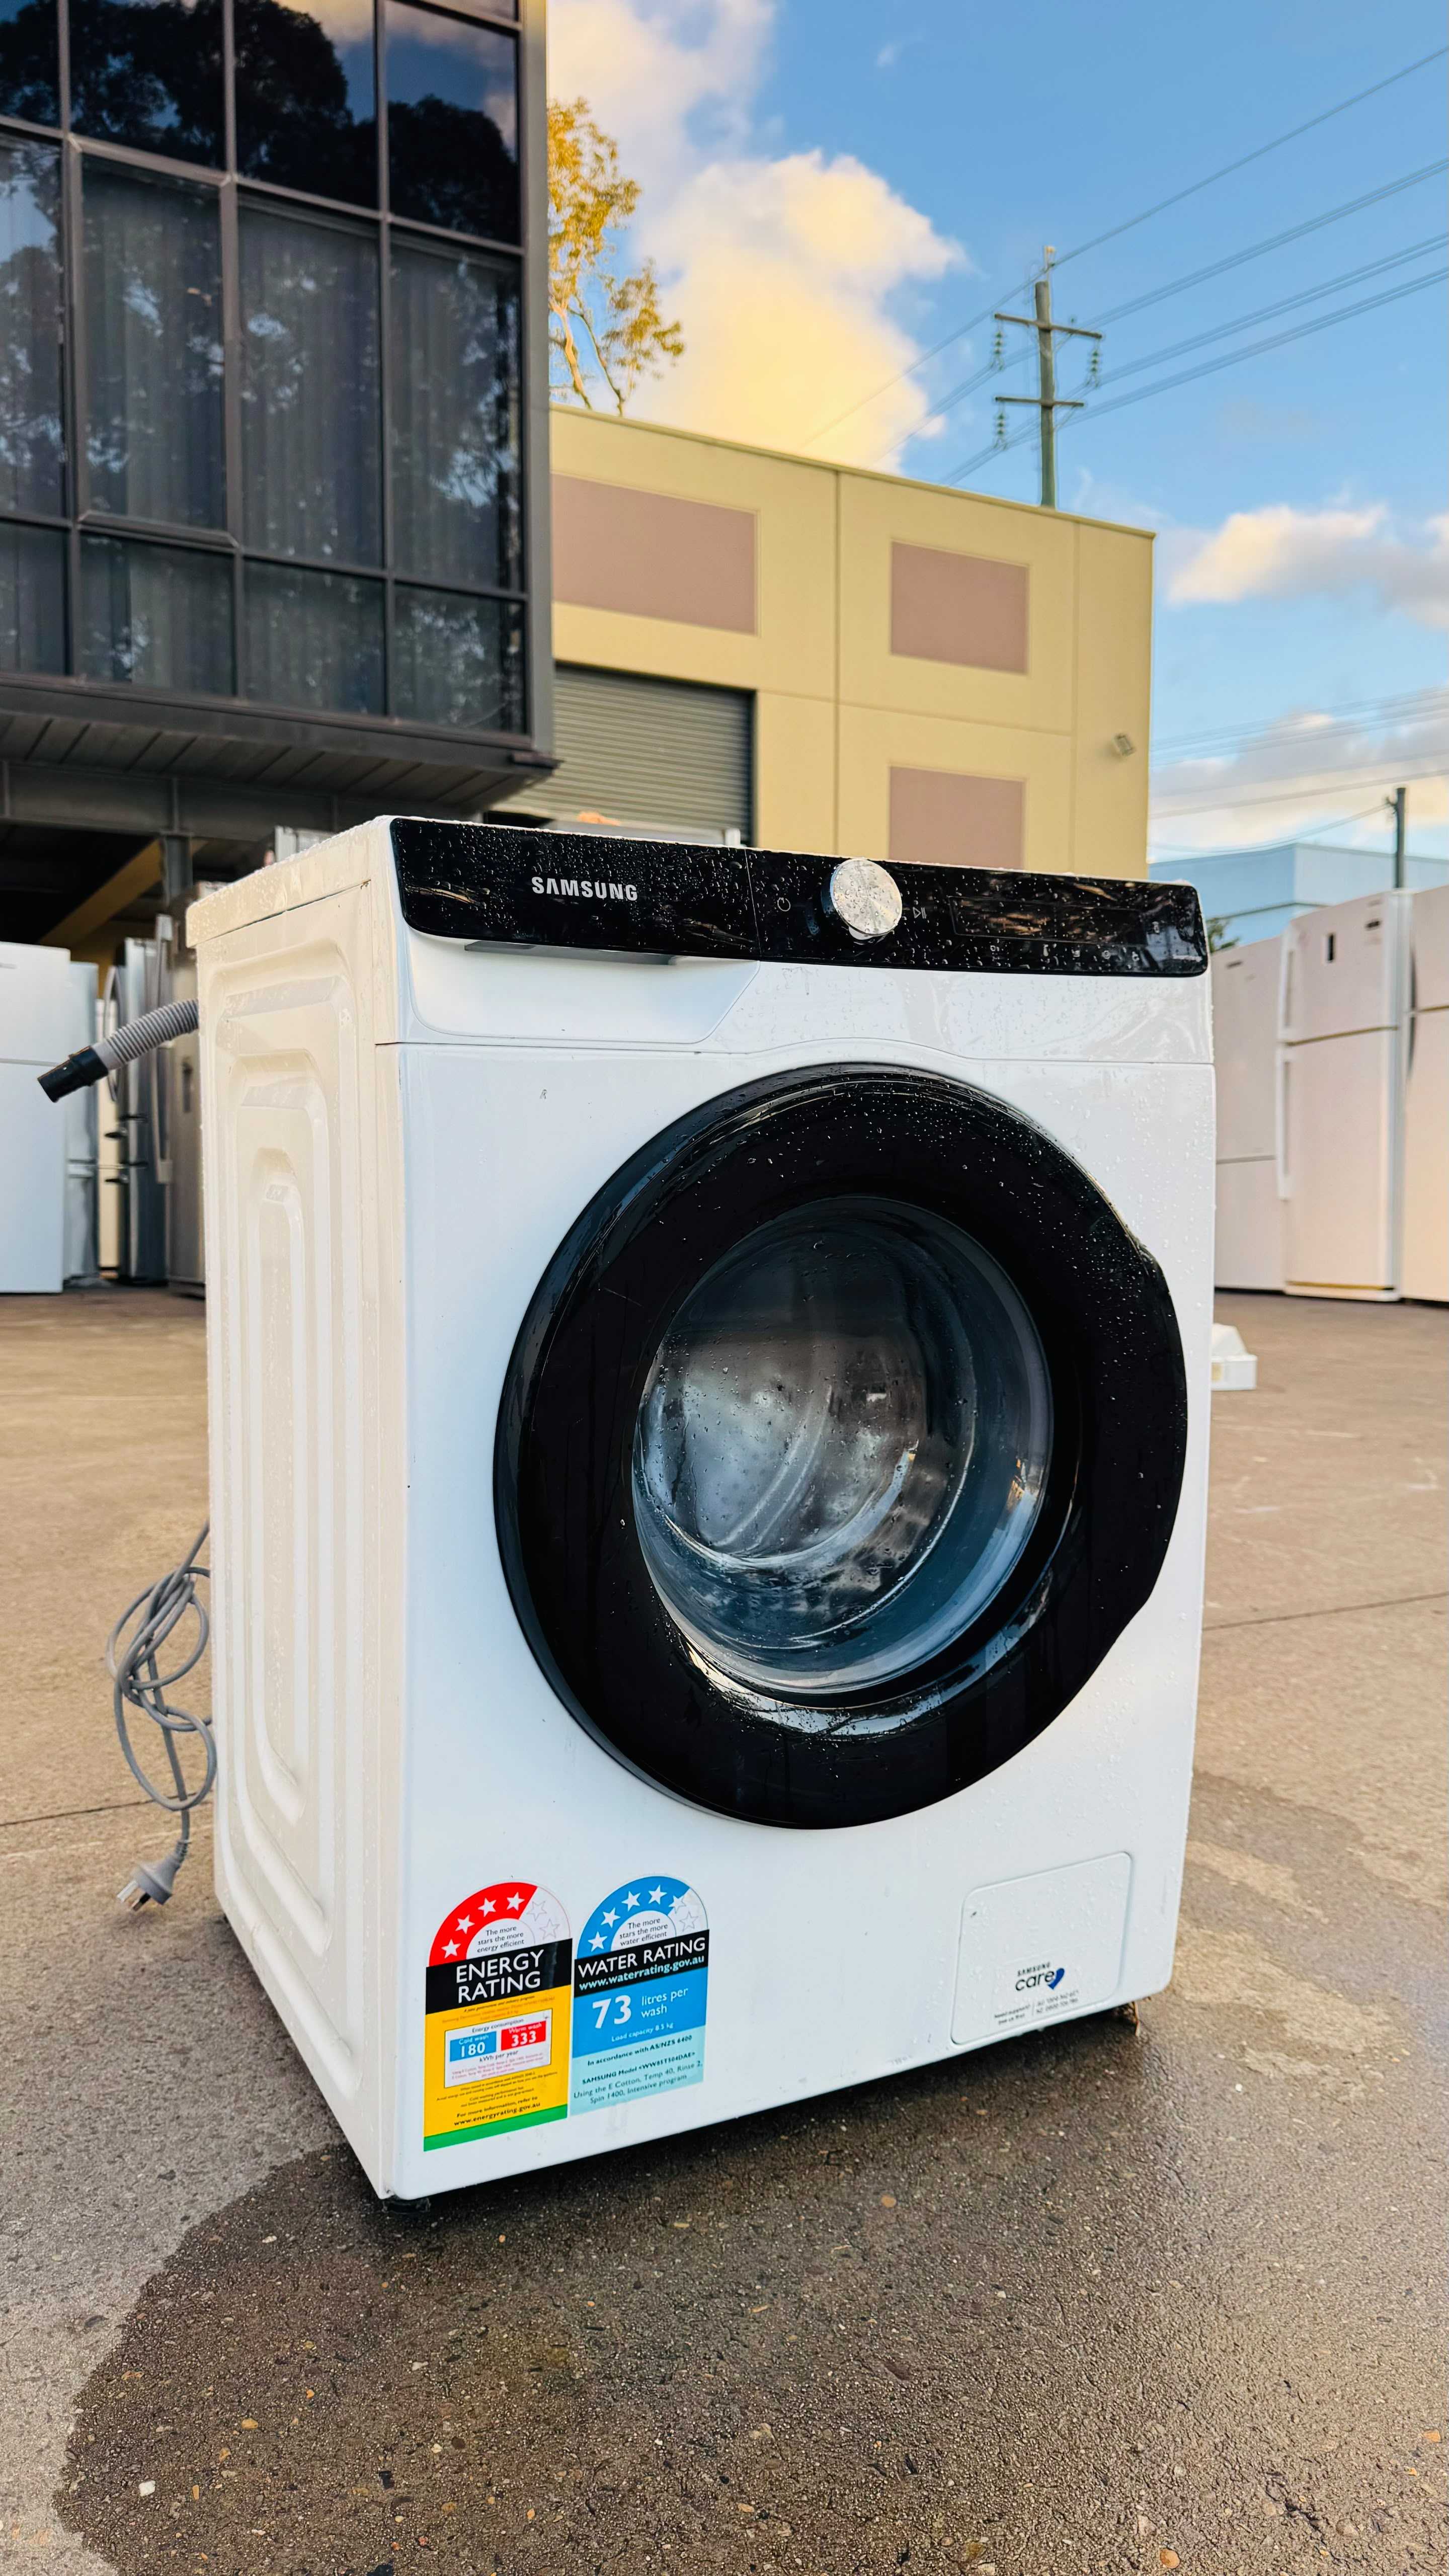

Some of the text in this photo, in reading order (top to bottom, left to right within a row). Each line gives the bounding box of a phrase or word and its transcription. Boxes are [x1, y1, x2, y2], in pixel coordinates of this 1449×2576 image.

[532, 876, 637, 901] SAMSUNG
[620, 1931, 635, 1939] stars
[650, 1924, 668, 1932] more
[641, 1932, 667, 1941] efficient
[501, 1940, 524, 1948] efficient
[456, 1950, 544, 1983] ENERGY
[578, 1937, 705, 1978] WATER RATING
[579, 1956, 704, 1990] www.waterrating.gov.au
[1015, 1971, 1055, 1991] care
[458, 1971, 540, 2003] RATING
[641, 1988, 688, 2006] litres per
[592, 1995, 631, 2029] 73
[641, 2004, 667, 2018] wash
[472, 2019, 523, 2033] Energy consumption
[611, 2033, 627, 2042] Load
[629, 2028, 654, 2037] capacity
[511, 2031, 536, 2047] 333
[461, 2042, 485, 2057] 180
[596, 2052, 632, 2064] accordance
[574, 2089, 593, 2099] Using
[644, 2072, 663, 2080] Temp
[677, 2063, 694, 2071] Rinse
[582, 2072, 616, 2084] SAMSUNG
[619, 2067, 637, 2076] Model
[627, 2082, 657, 2094] Intensive
[659, 2075, 687, 2087] program
[454, 2103, 540, 2126] www.energyrating.gov.au
